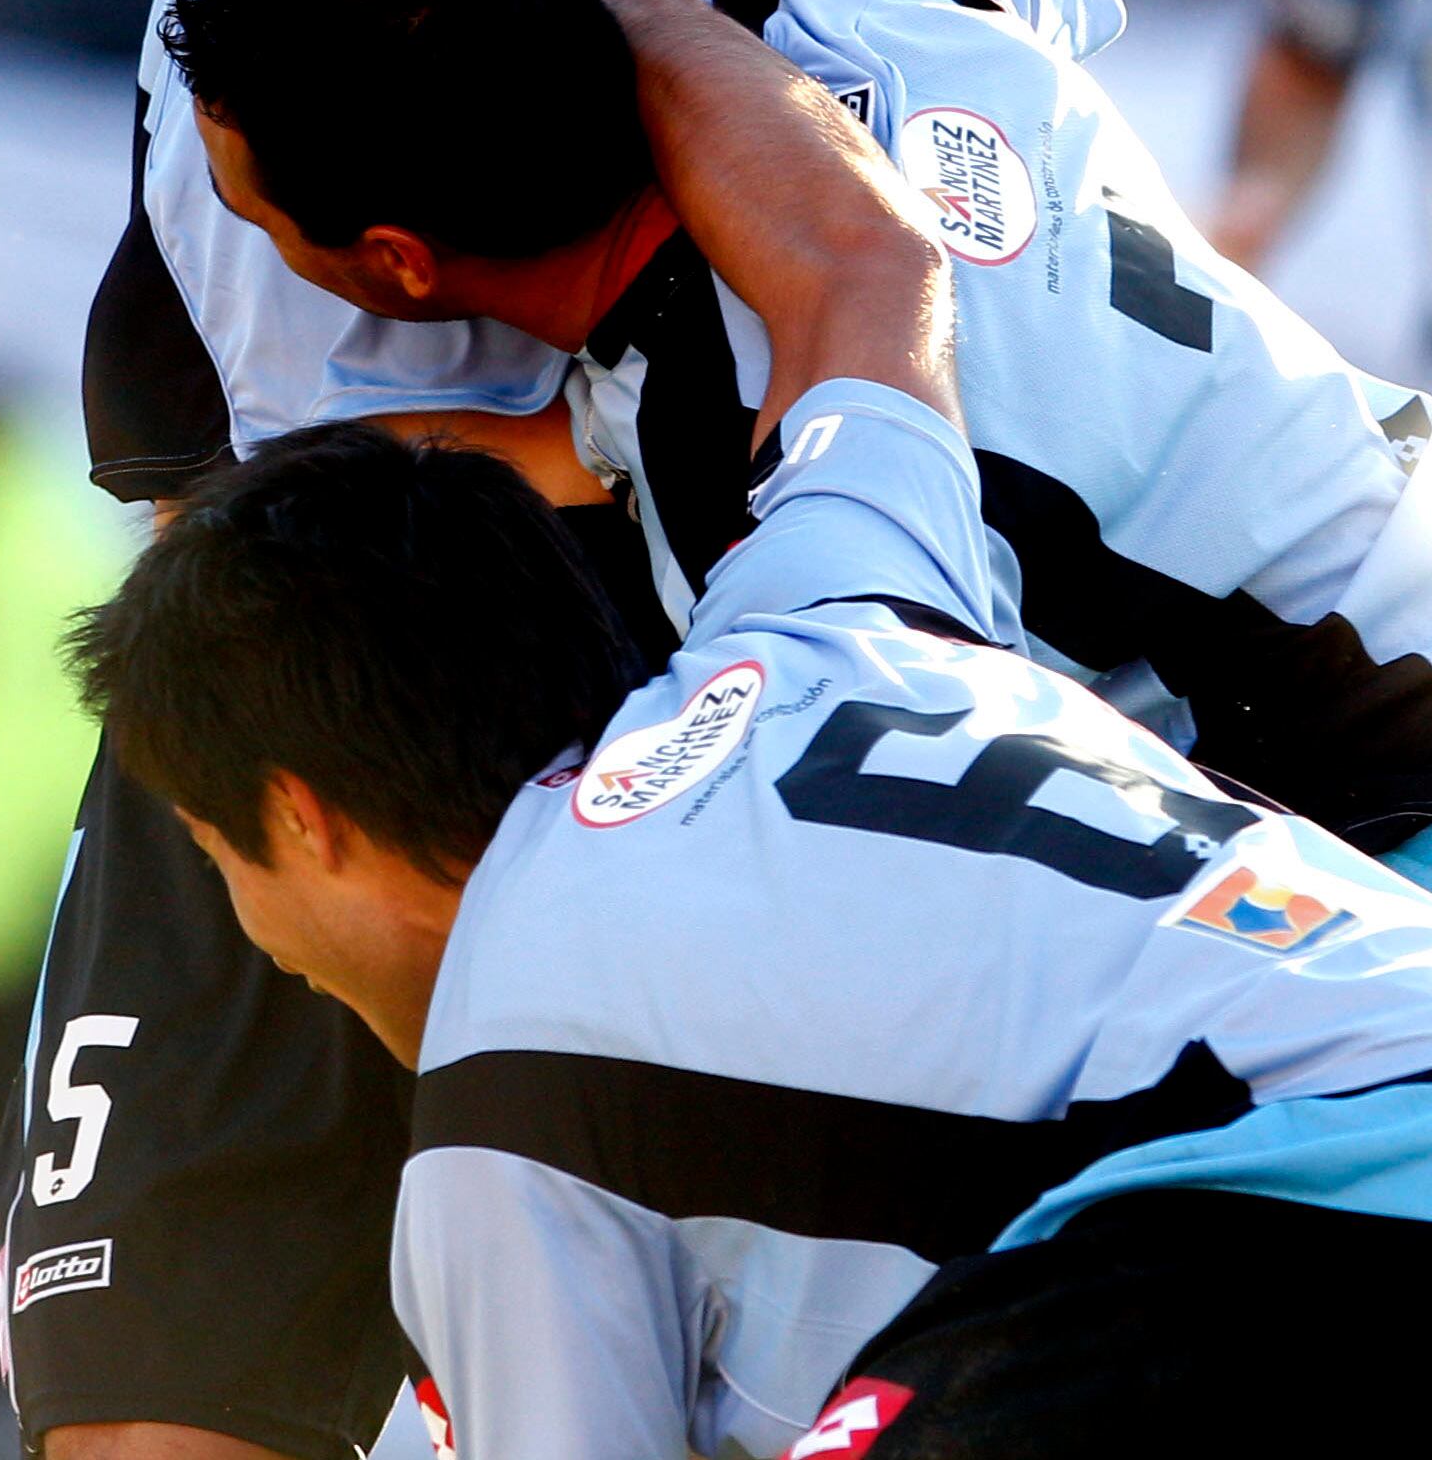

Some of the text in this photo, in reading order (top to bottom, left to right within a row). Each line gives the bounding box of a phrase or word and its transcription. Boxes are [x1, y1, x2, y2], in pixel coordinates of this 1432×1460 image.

[967, 129, 1005, 251] MARTINEZ
[619, 681, 756, 810] MARTINEZ
[775, 699, 1264, 901] 6
[31, 1014, 140, 1207] 5
[29, 1255, 102, 1291] lotto
